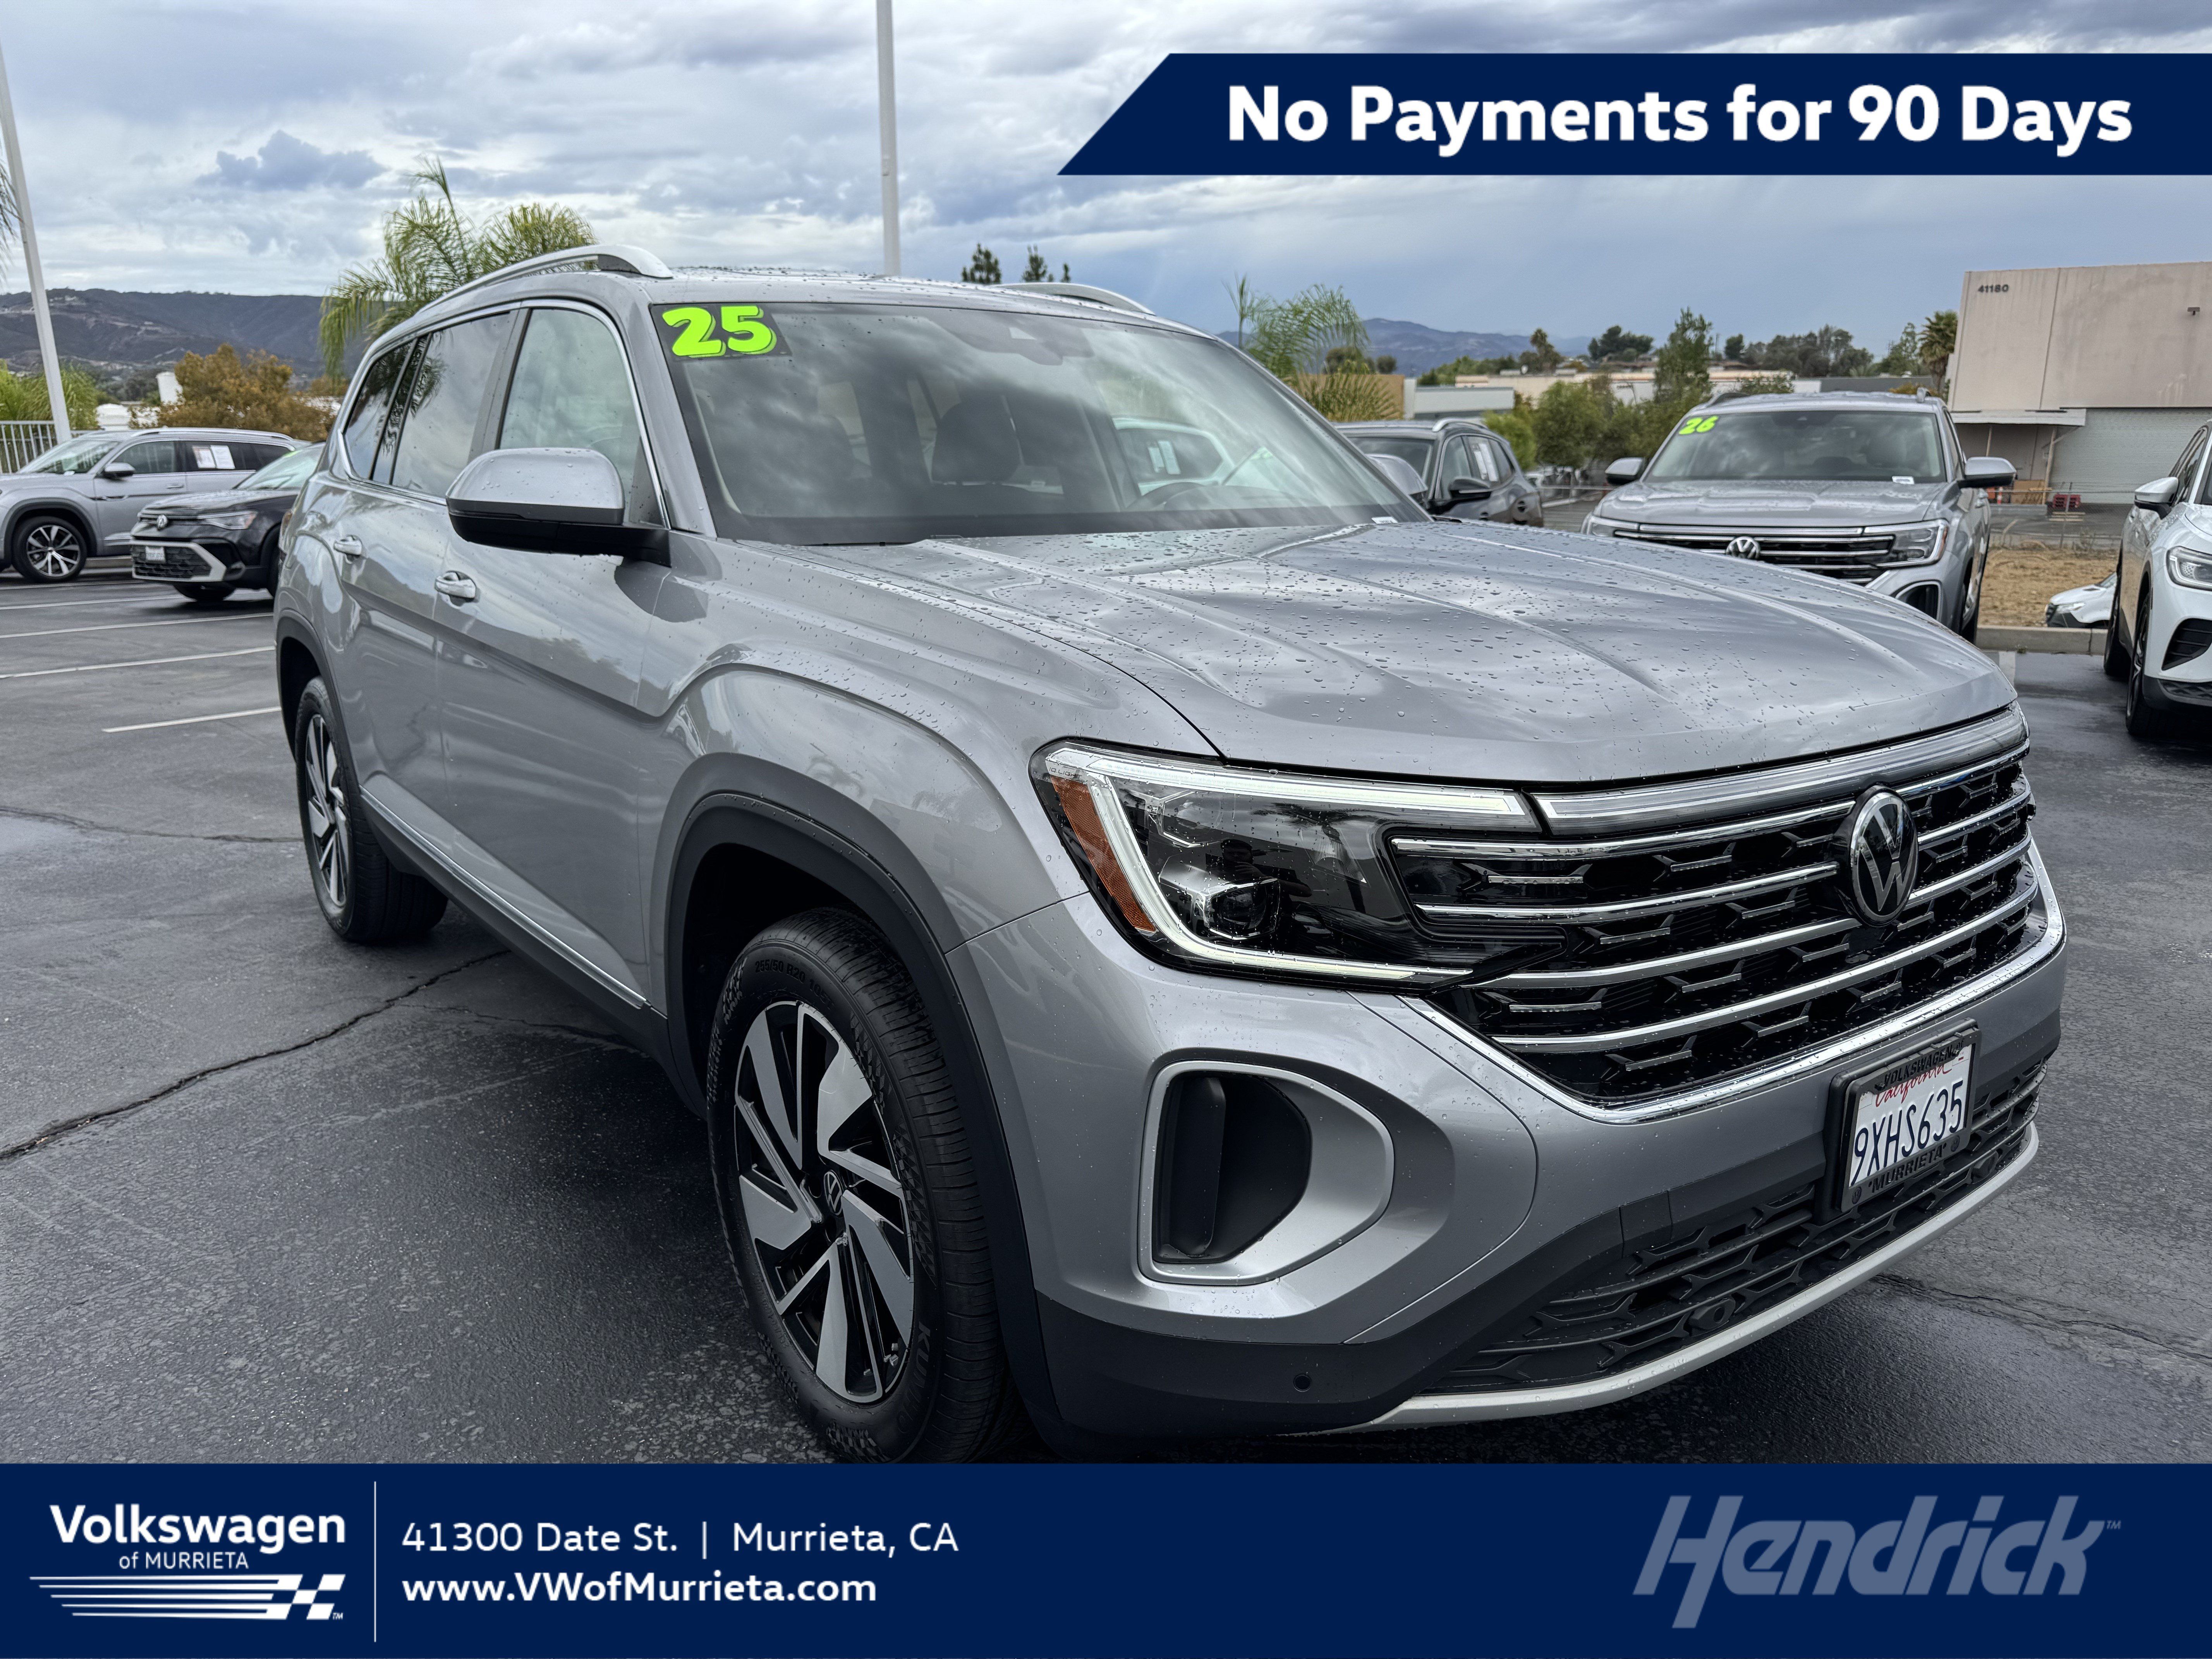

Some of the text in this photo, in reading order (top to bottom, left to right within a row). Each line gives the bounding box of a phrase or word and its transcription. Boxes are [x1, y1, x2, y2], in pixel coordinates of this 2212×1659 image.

[1978, 284, 2009, 293] 41180
[661, 305, 777, 358] 25
[1679, 416, 1719, 434] 26
[755, 959, 784, 973] 255/50
[1884, 1044, 1953, 1085] VOLKSWAGEN
[1850, 1080, 1964, 1186] 9XHS635
[1871, 1146, 1941, 1194] MURRIETA
